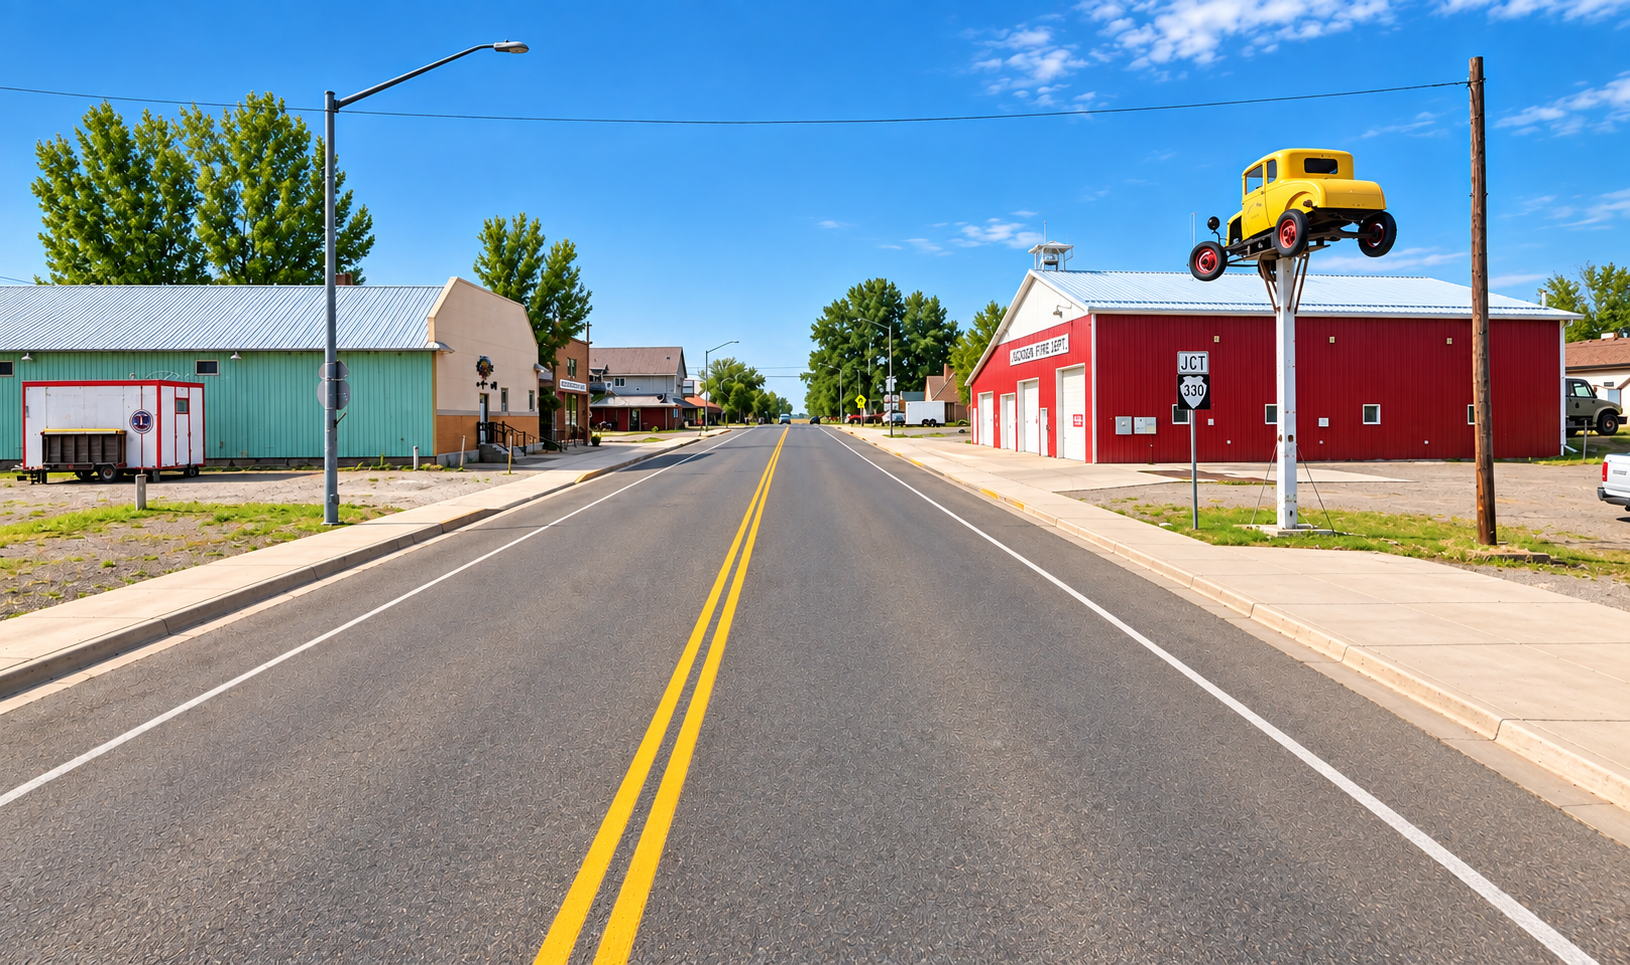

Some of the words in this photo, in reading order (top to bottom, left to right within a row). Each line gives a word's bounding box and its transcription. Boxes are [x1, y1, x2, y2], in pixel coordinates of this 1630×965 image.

[1035, 342, 1050, 357] FIRE
[1181, 355, 1206, 371] JCT
[1183, 384, 1204, 397] 330
